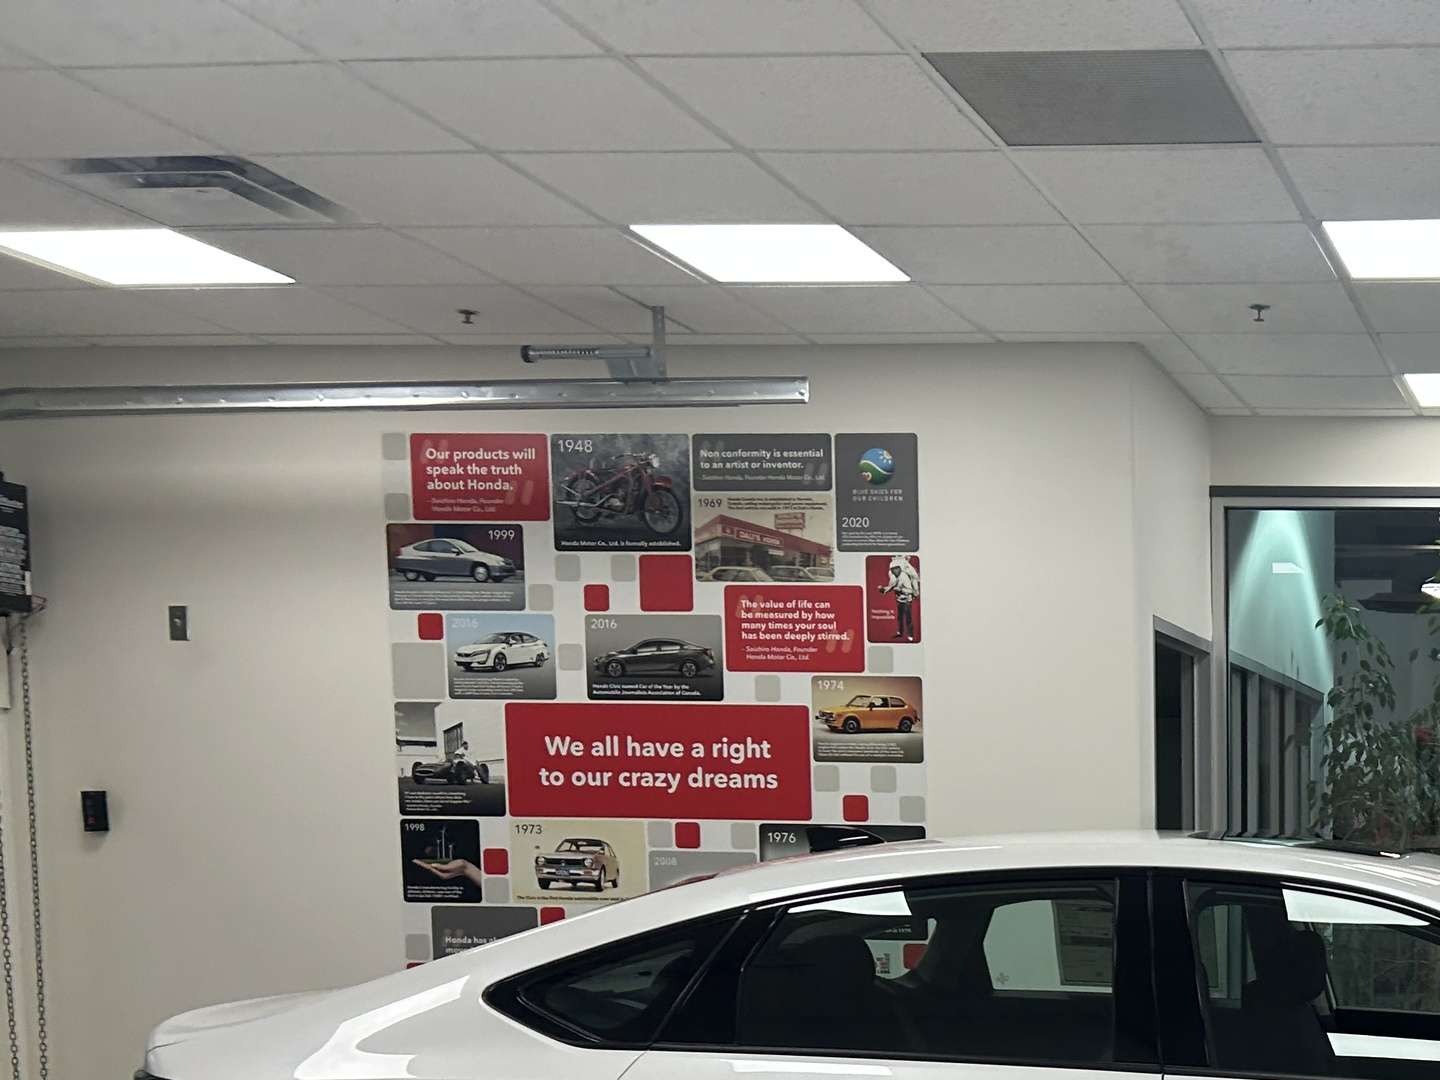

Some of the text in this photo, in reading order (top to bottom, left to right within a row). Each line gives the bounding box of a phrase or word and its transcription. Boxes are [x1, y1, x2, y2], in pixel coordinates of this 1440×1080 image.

[558, 440, 592, 453] 1948
[425, 447, 535, 462] Our products will
[700, 448, 824, 459] Non conformity is essential
[426, 463, 522, 477] speak the truth
[700, 461, 709, 469] to
[725, 461, 748, 469] artist
[762, 461, 804, 469] inventor.
[427, 478, 513, 490] about Honda.
[698, 498, 722, 508] 1969
[842, 517, 869, 528] 2020
[488, 529, 514, 540] 1999
[740, 600, 758, 608] The
[760, 600, 784, 608] value
[786, 600, 796, 608] of
[798, 600, 813, 608] life
[741, 610, 835, 621] be measured by how
[591, 618, 617, 629] 2016
[741, 621, 836, 631] many times your soul
[741, 631, 850, 642] has been deeply stirred.
[817, 680, 844, 691] 1974
[544, 735, 772, 764] We all have a right
[538, 767, 779, 793] to our crazy dreams
[404, 823, 425, 832] 1998
[514, 824, 543, 835] 1973
[767, 832, 797, 843] 1976
[445, 935, 472, 944] Honda
